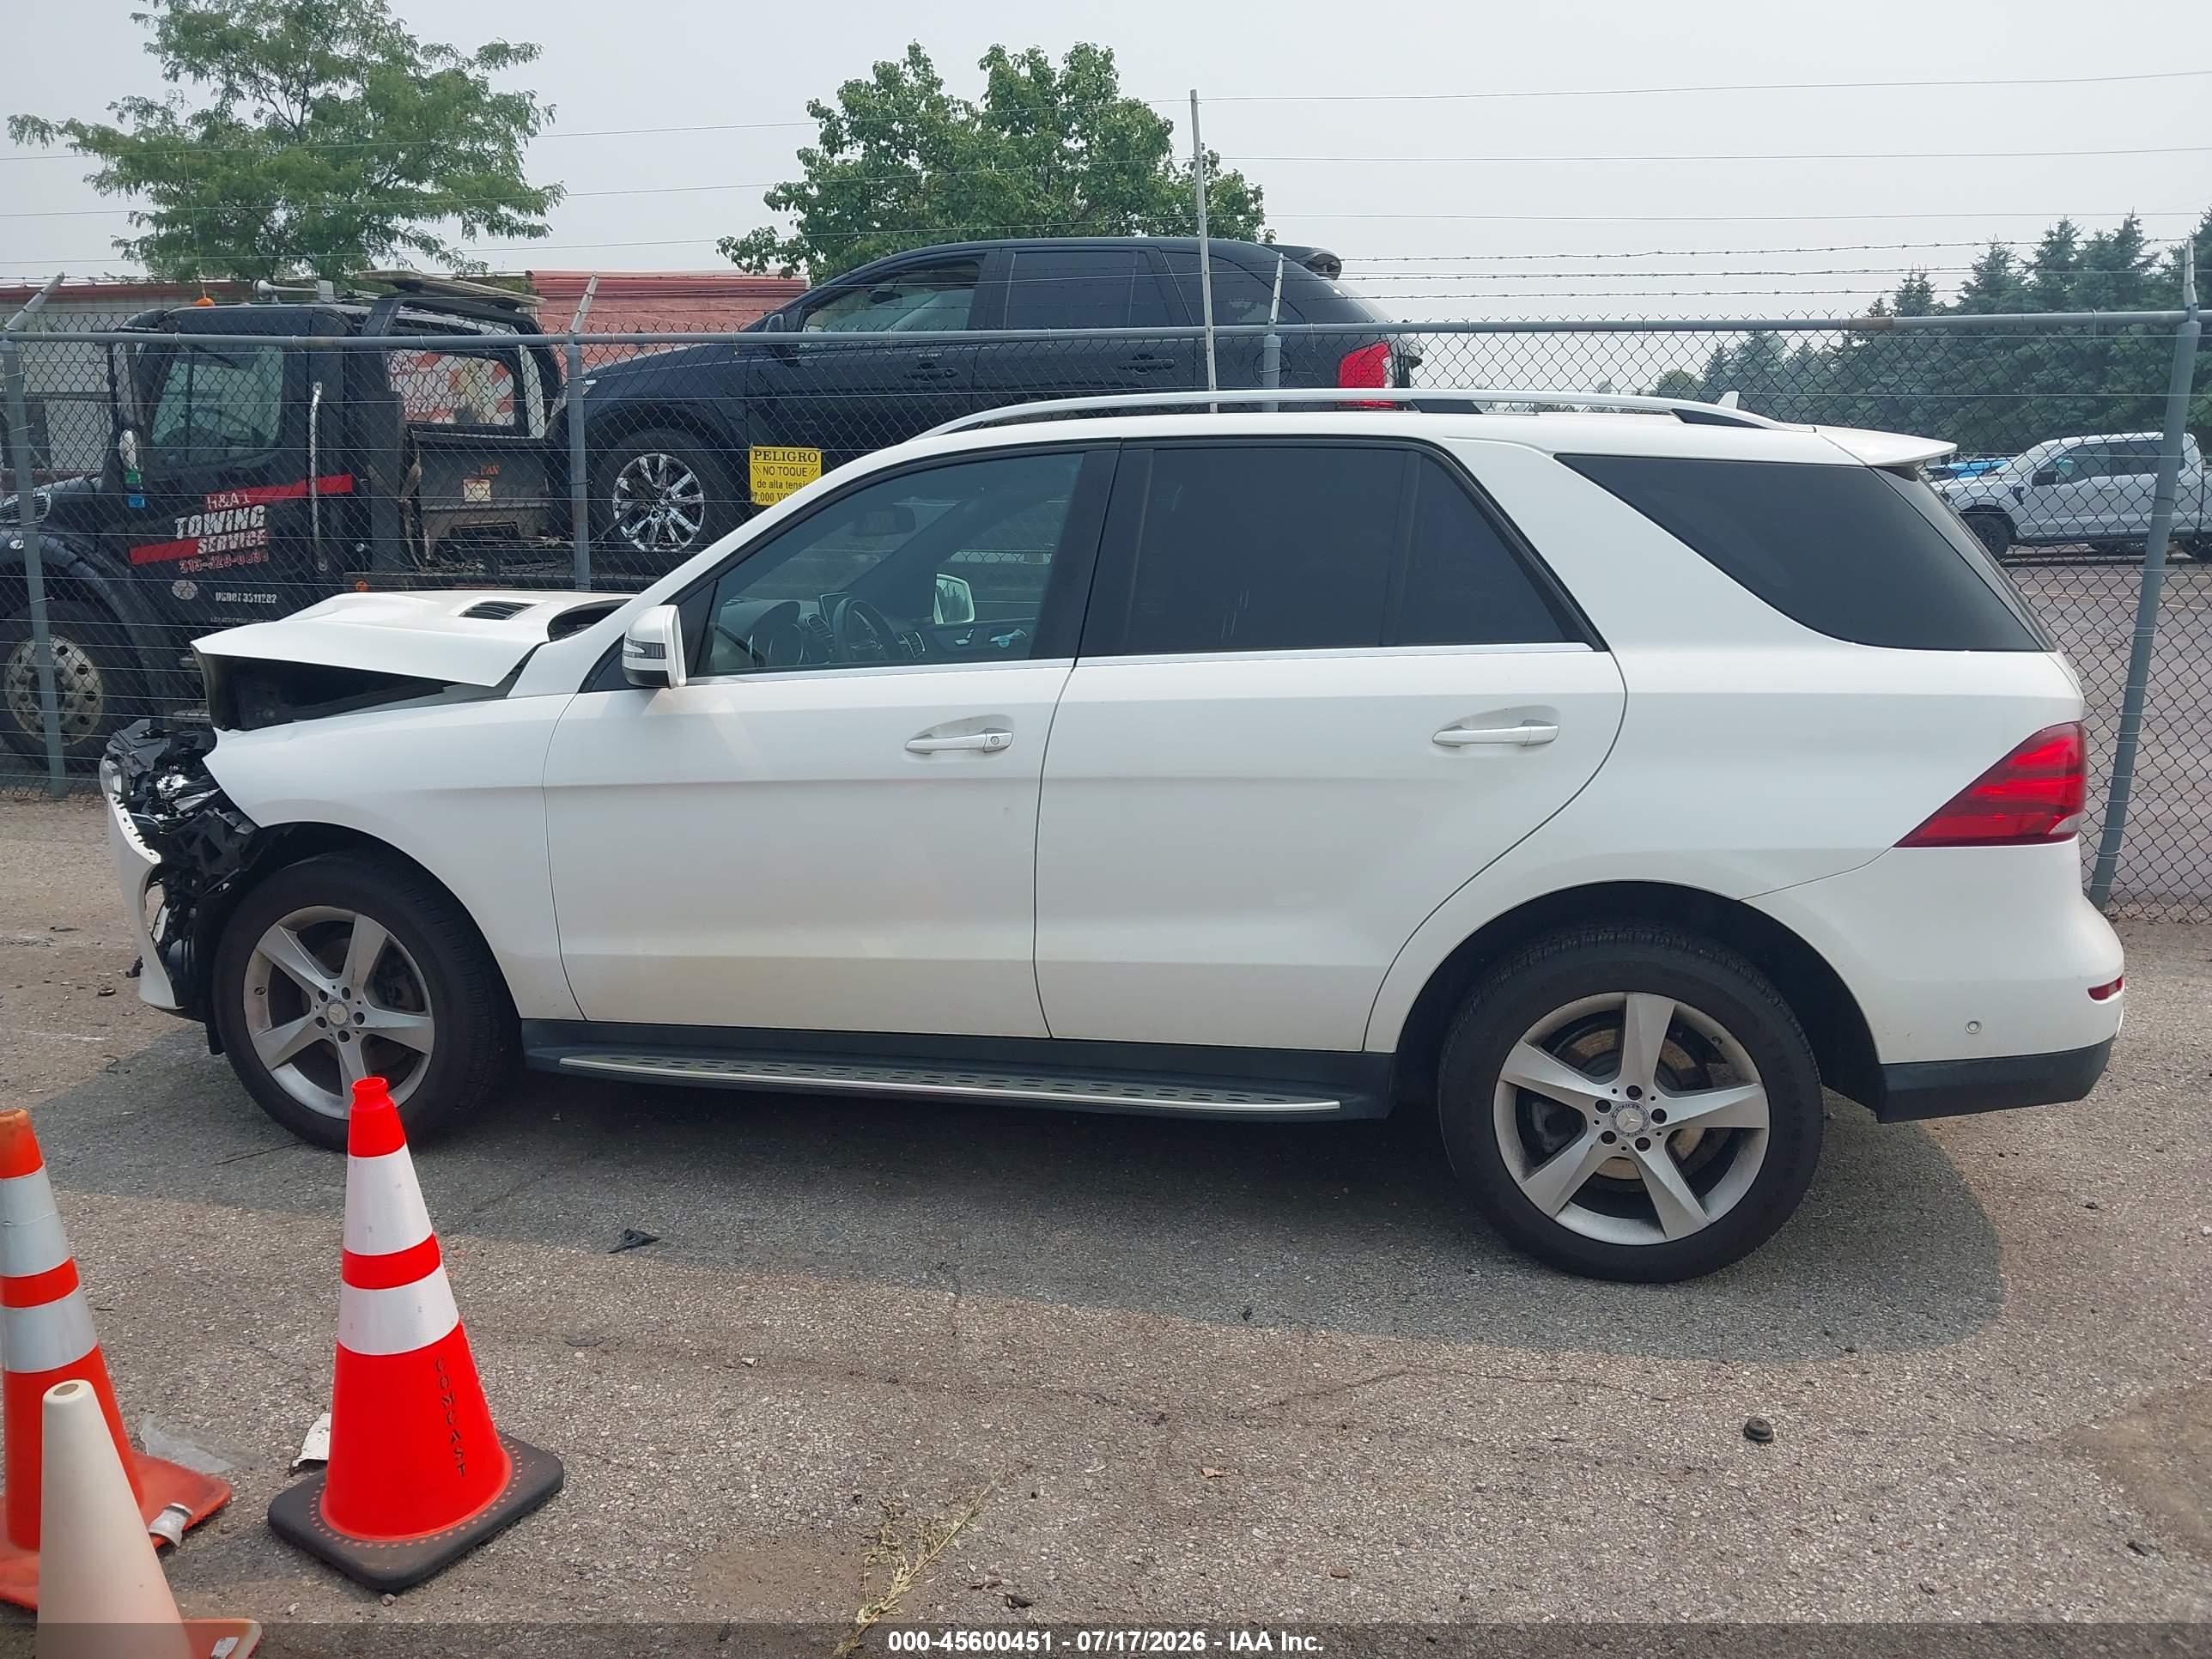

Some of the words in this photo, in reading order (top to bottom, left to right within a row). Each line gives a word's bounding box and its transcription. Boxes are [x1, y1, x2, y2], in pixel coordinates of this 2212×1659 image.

[753, 450, 817, 463] PELIGRO
[763, 465, 775, 476] NO
[778, 466, 807, 477] TOQUE
[757, 479, 767, 489] de
[769, 479, 783, 489] alta
[174, 504, 265, 539] TOWING
[197, 529, 267, 554] SERVICE
[434, 1356, 465, 1478] COMCAST
